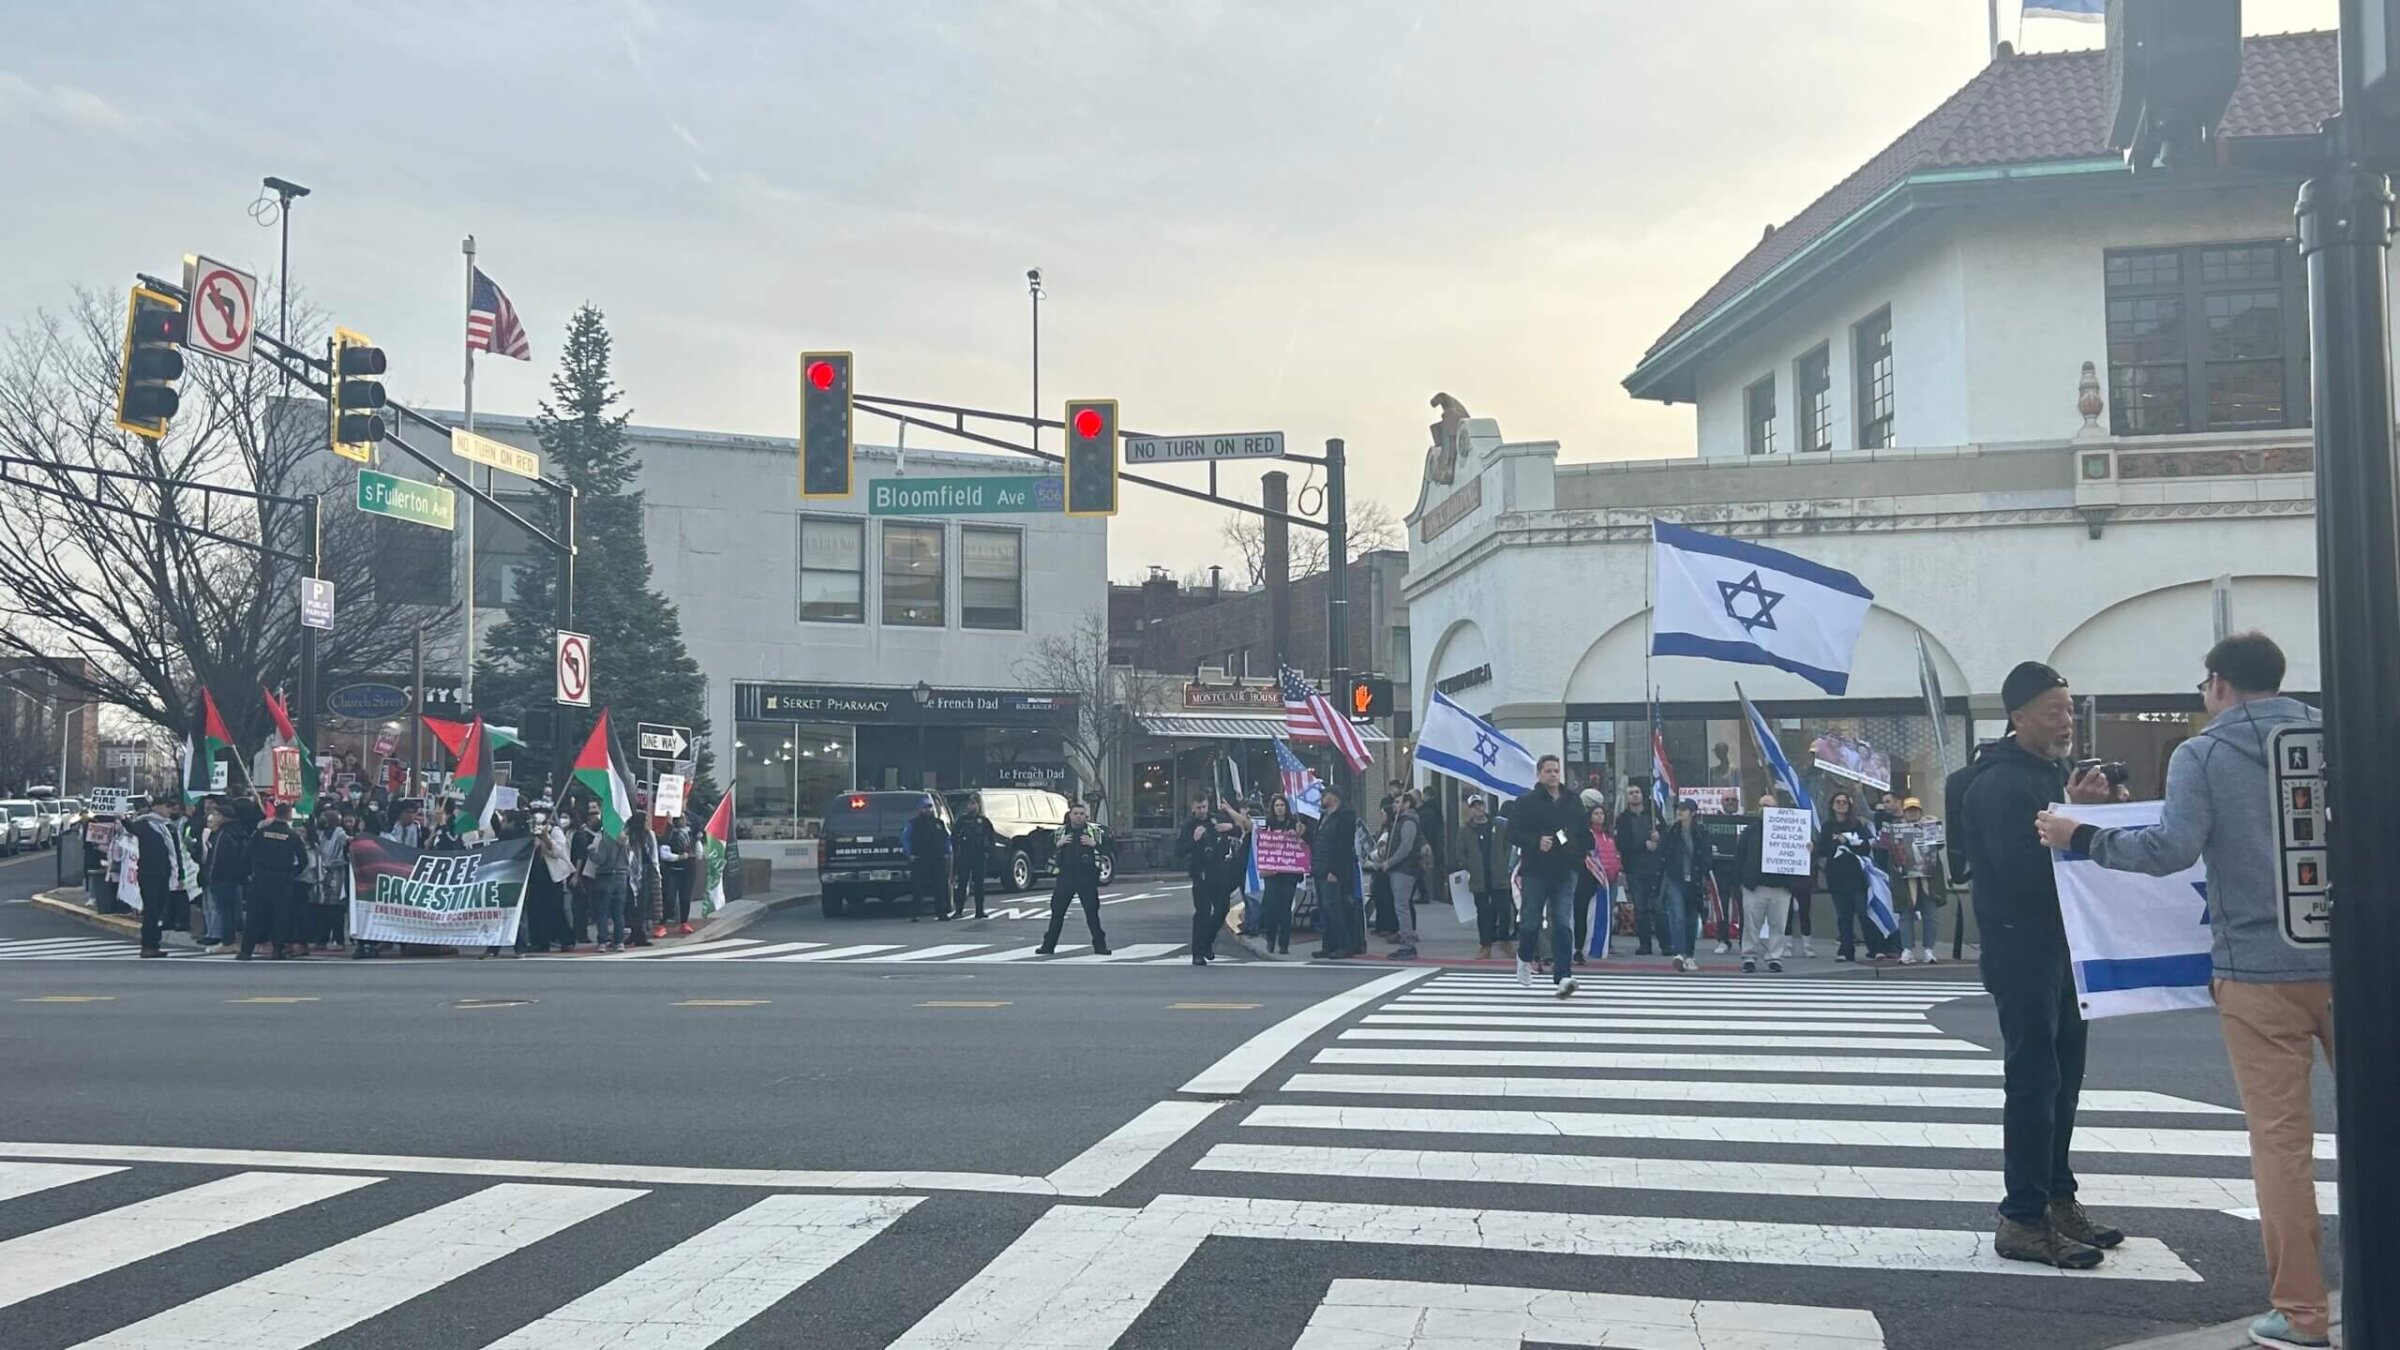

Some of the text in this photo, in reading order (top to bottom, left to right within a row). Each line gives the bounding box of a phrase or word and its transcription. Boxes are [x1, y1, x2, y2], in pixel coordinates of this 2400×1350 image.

[457, 434, 533, 473] NO TURN ON RED
[1134, 437, 1275, 458] NO TURN ON RED
[365, 483, 450, 517] S Fullerton Ave
[876, 485, 1026, 508] Bloomfield Ave
[1038, 488, 1062, 501] 506
[313, 582, 324, 601] P
[371, 693, 405, 709] Street
[783, 696, 889, 712] SERKET PHARMACY
[937, 697, 974, 709] French
[977, 697, 999, 710] Dad
[1192, 691, 1278, 703] MONTCLAIR HOUSE
[642, 734, 678, 750] ONE WAY
[1000, 768, 1065, 780] Le French Dad
[93, 789, 128, 797] CEASE
[1788, 834, 1804, 842] FOR
[835, 847, 889, 855] MONTCLAIR
[1778, 850, 1796, 858] AND
[1277, 857, 1297, 865] Fight
[410, 853, 483, 888] FREE
[377, 873, 500, 914] PALESTINE
[375, 904, 388, 914] END
[389, 905, 403, 917] THE
[404, 906, 445, 922] GENOCIDAL
